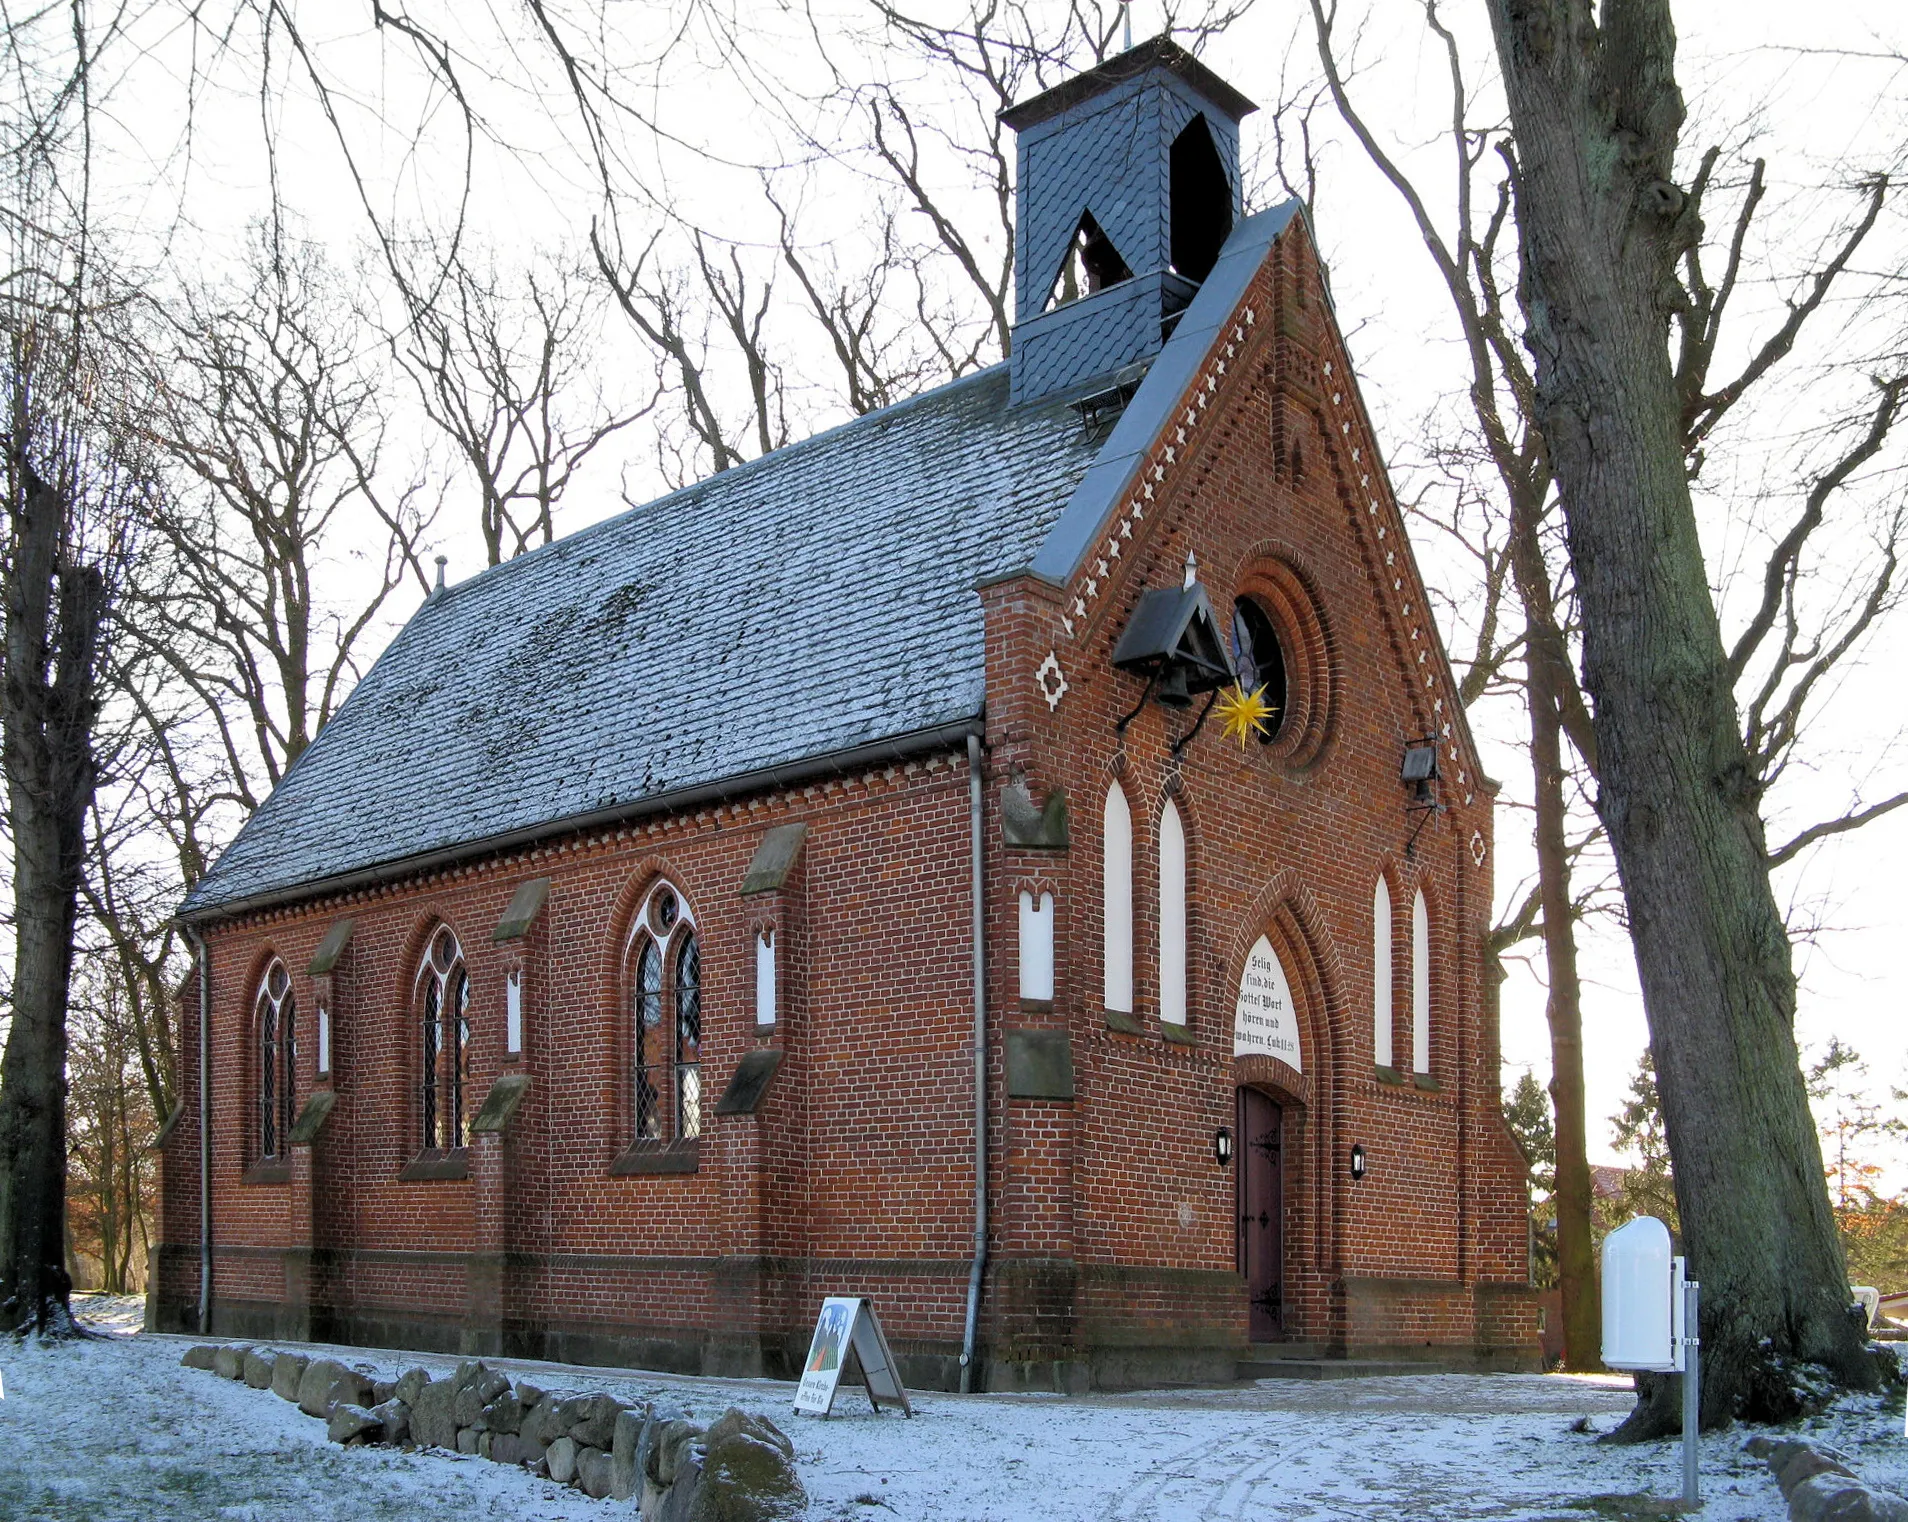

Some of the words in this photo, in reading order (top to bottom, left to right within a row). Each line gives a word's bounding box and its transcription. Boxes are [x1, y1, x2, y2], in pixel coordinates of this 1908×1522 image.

[1251, 955, 1271, 973] Selig
[1262, 994, 1282, 1011] Wort
[1242, 1009, 1264, 1025] hören
[1265, 1017, 1279, 1029] und
